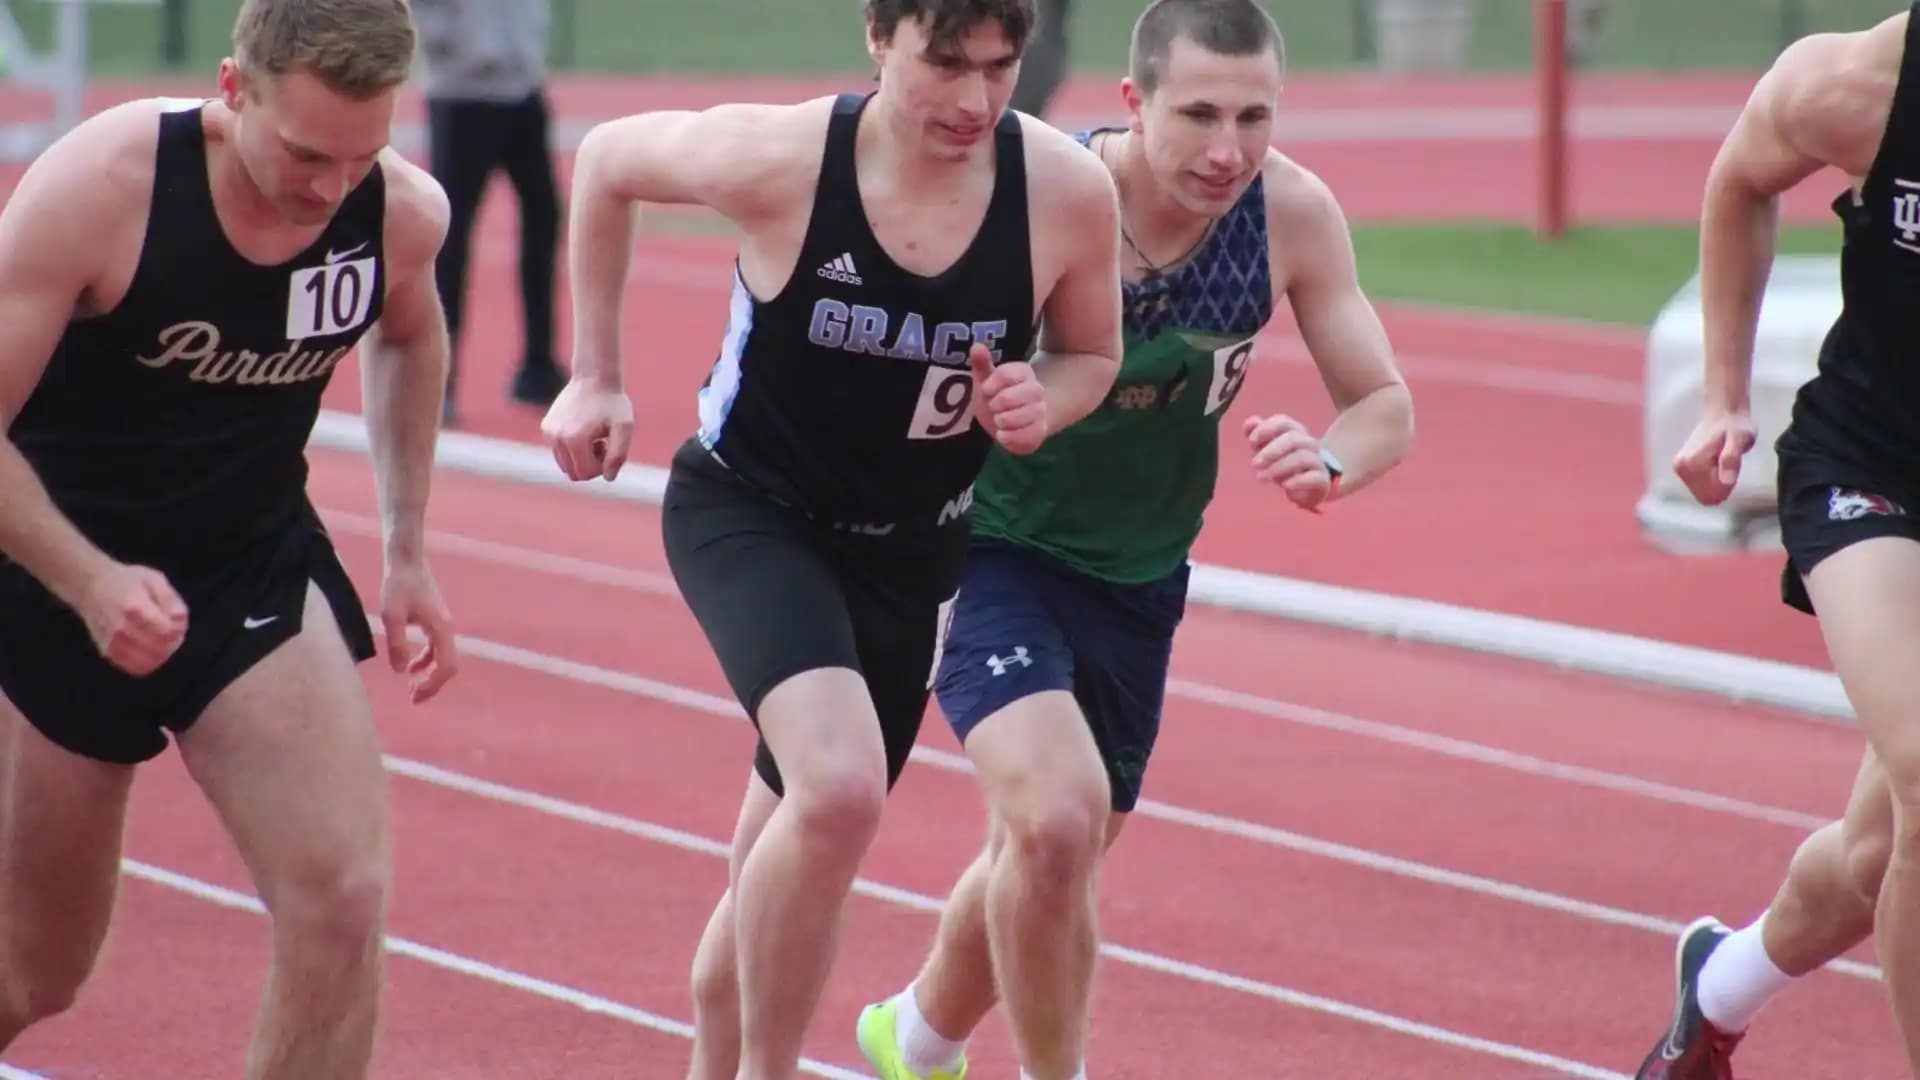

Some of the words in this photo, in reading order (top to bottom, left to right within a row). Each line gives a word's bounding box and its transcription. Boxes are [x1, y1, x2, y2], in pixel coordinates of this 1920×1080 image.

[305, 265, 361, 331] 10
[816, 266, 863, 286] adidas
[136, 320, 348, 385] Purdue
[808, 298, 1008, 366] GRACE
[1217, 341, 1254, 402] 8
[925, 373, 975, 436] 9
